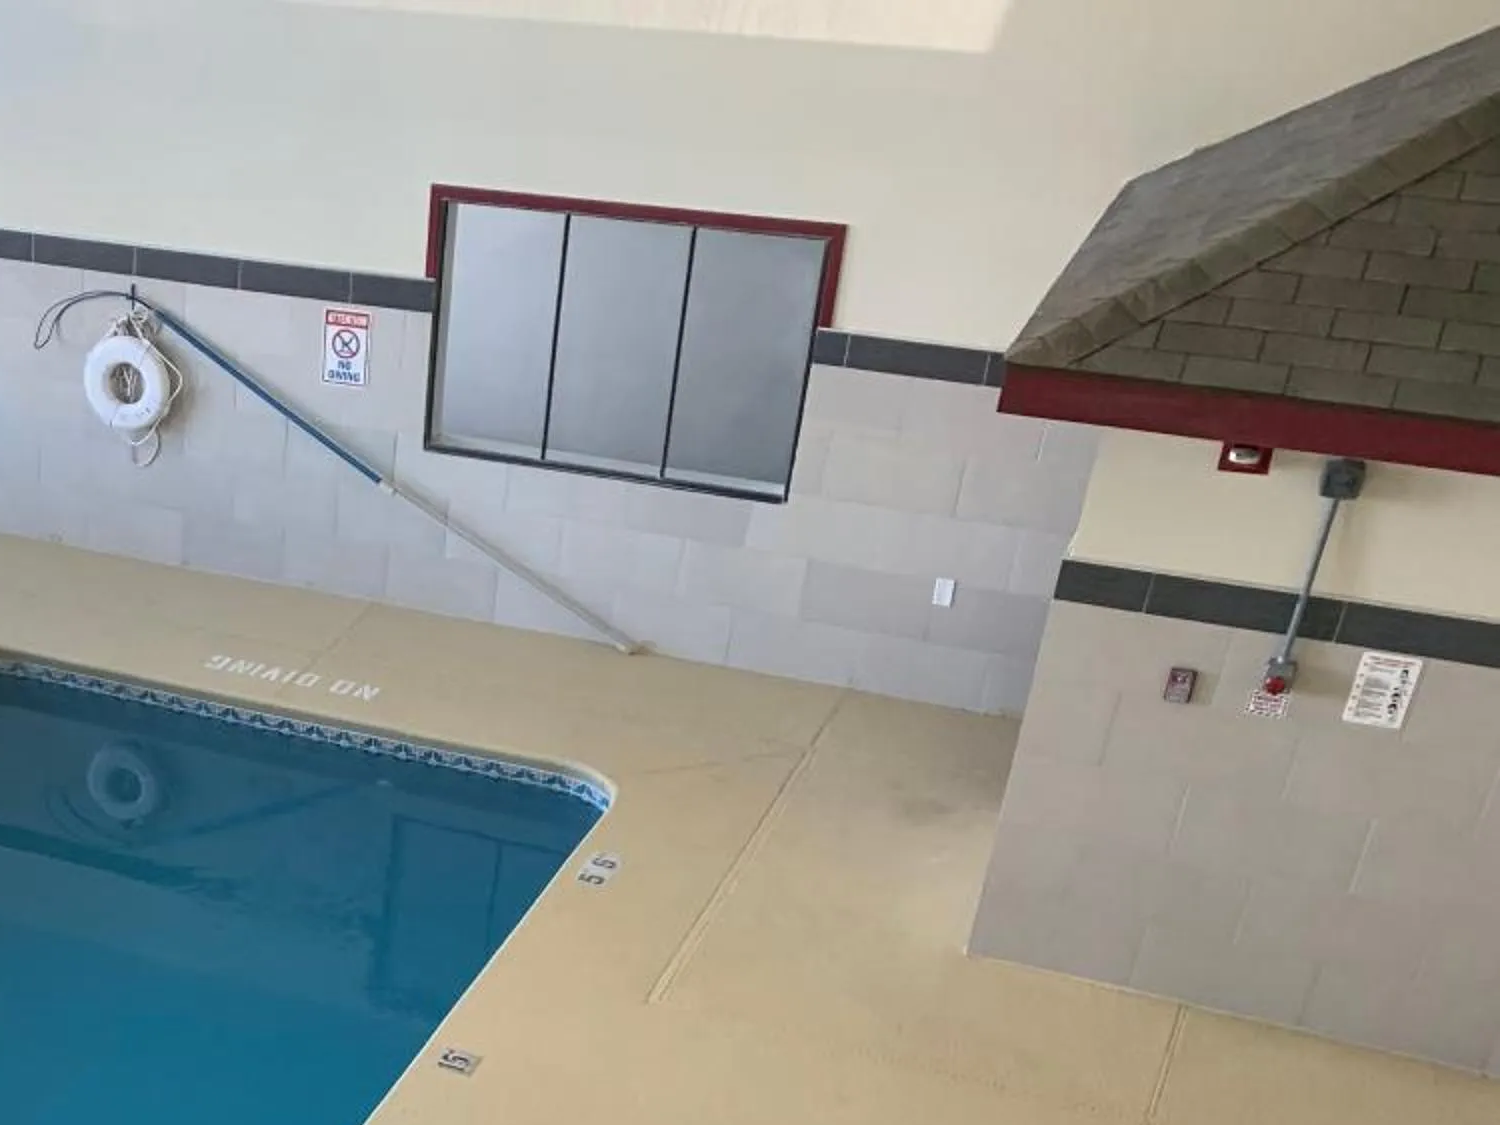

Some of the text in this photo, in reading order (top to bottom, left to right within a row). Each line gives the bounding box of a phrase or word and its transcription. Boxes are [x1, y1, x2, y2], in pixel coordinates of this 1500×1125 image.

[327, 369, 361, 382] DIVING
[204, 654, 380, 700] NO DIVING
[578, 873, 605, 885] 5
